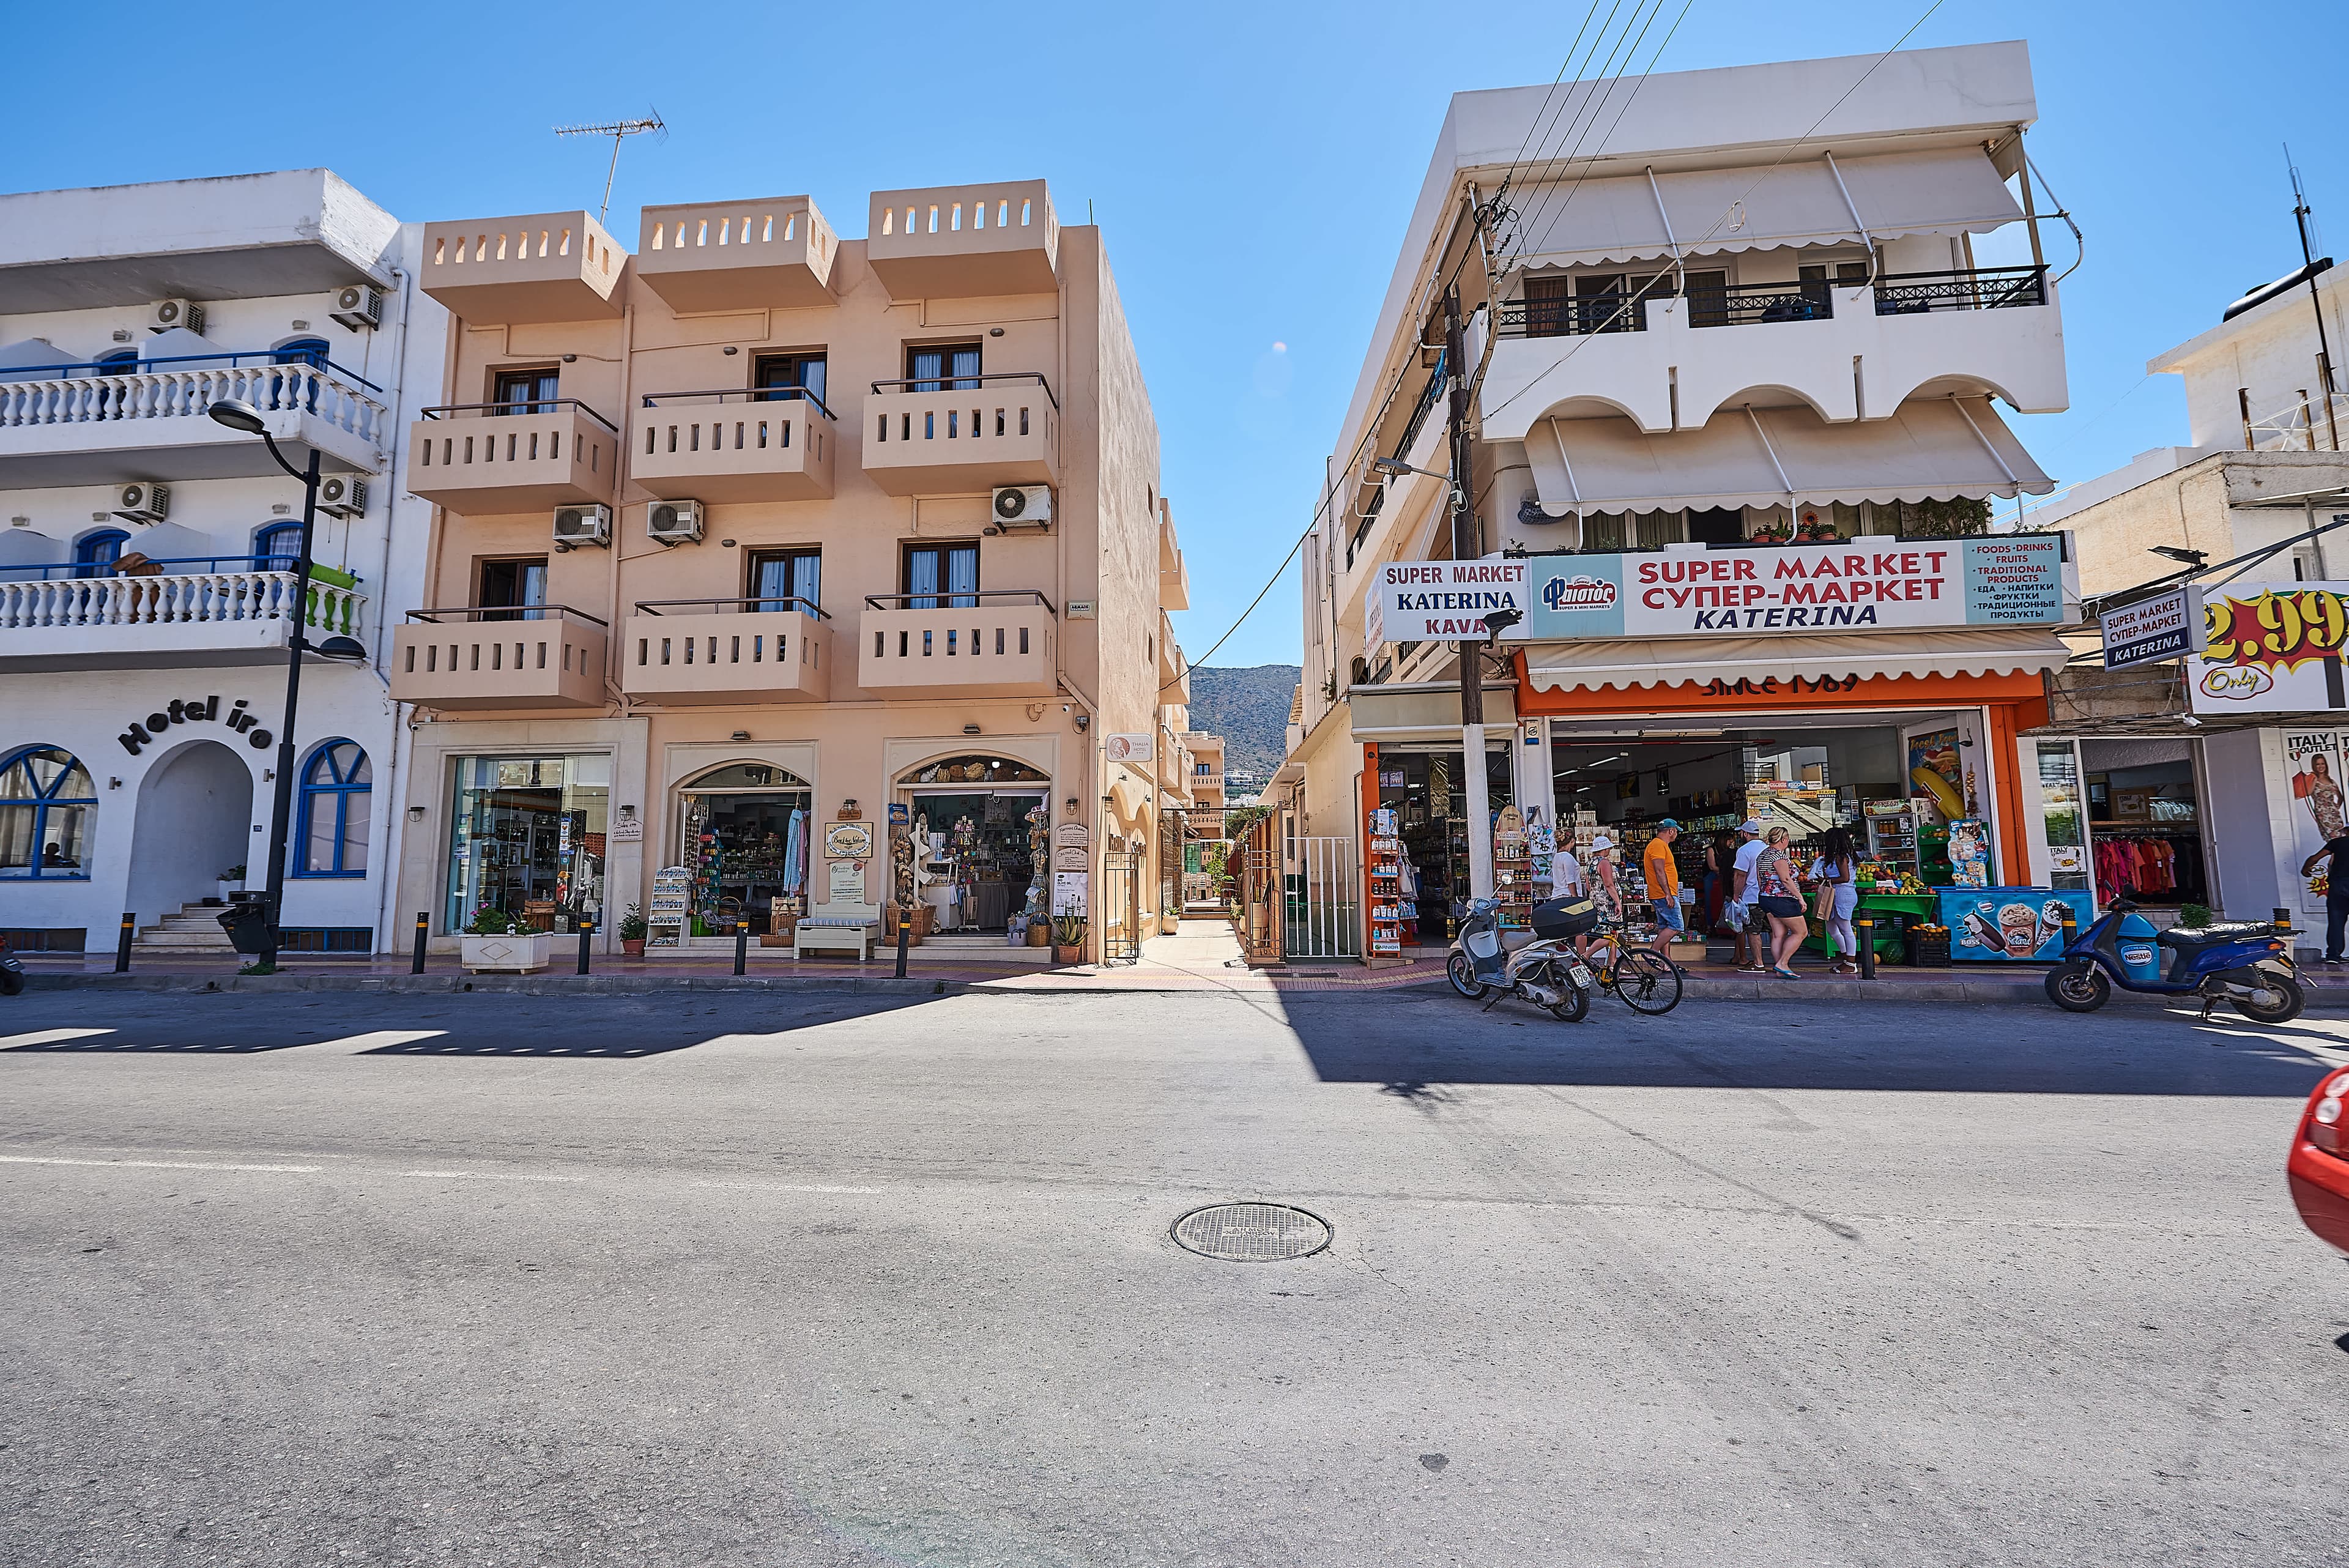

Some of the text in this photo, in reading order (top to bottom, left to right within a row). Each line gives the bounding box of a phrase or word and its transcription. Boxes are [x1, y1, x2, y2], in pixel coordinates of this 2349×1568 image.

[1386, 565, 1524, 584] SUPER MARKET
[1638, 551, 1948, 584] SUPER MARKET
[1978, 565, 2048, 574] TRADITIONAL
[1987, 574, 2039, 583] PRODUCTS
[1397, 592, 1516, 610] KATERINA
[1642, 578, 1945, 609] СУПЕР-МАРКЕТ
[1978, 601, 2056, 610] ТРАДИЦИОННЫЕ
[2108, 598, 2181, 630] SUPER MARKET
[1425, 619, 1488, 634] KAVA
[1693, 605, 1878, 630] KATERINA
[2110, 613, 2181, 642] СУПЕР-МАРКЕТ
[2115, 634, 2181, 662] KATERINA
[2208, 667, 2259, 691] Only
[117, 695, 273, 756] Hotel iro
[2288, 734, 2329, 748] ITALY
[2300, 743, 2337, 754] OUTLET
